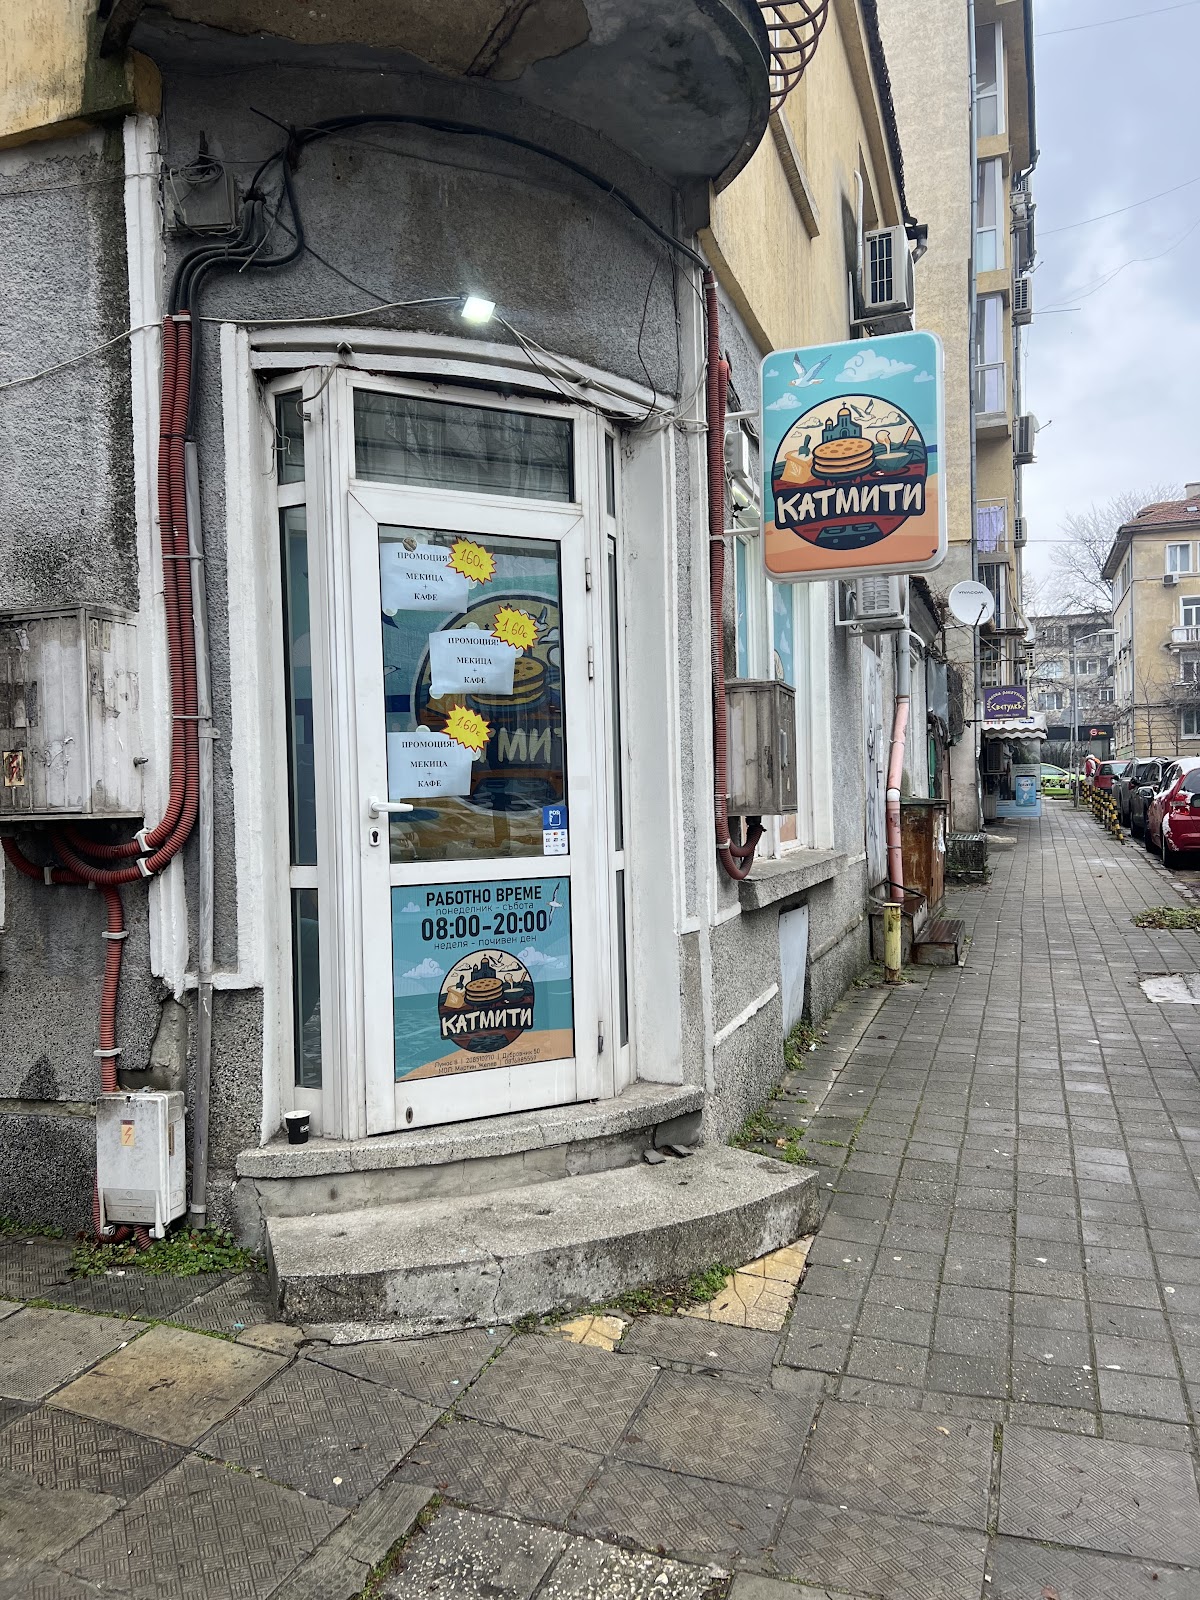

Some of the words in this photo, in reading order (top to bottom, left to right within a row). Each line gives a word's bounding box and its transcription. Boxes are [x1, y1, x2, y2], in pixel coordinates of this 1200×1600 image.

[777, 482, 922, 524] КАТМИТИ
[405, 572, 444, 582] МЕКИЦА
[414, 592, 438, 601] КАФЕ
[448, 637, 499, 646] ПРОМОЦИЯ!
[456, 656, 492, 665] МЕКИЦА
[464, 676, 487, 684] КАФЕ
[401, 740, 455, 748] ПРОМОЦИЯ!
[410, 760, 448, 768] МЕКИЦА
[418, 780, 442, 788] КАФЕ
[426, 888, 491, 907] РАБОТНО
[496, 885, 542, 902] ВРЕМЕ
[435, 904, 493, 916] понеделник
[502, 902, 534, 911] събота
[434, 940, 468, 950] неделя
[478, 937, 517, 947] почивен
[519, 935, 537, 944] ден
[441, 1007, 532, 1036] КАТМИТИ
[454, 1064, 477, 1073] Мартин
